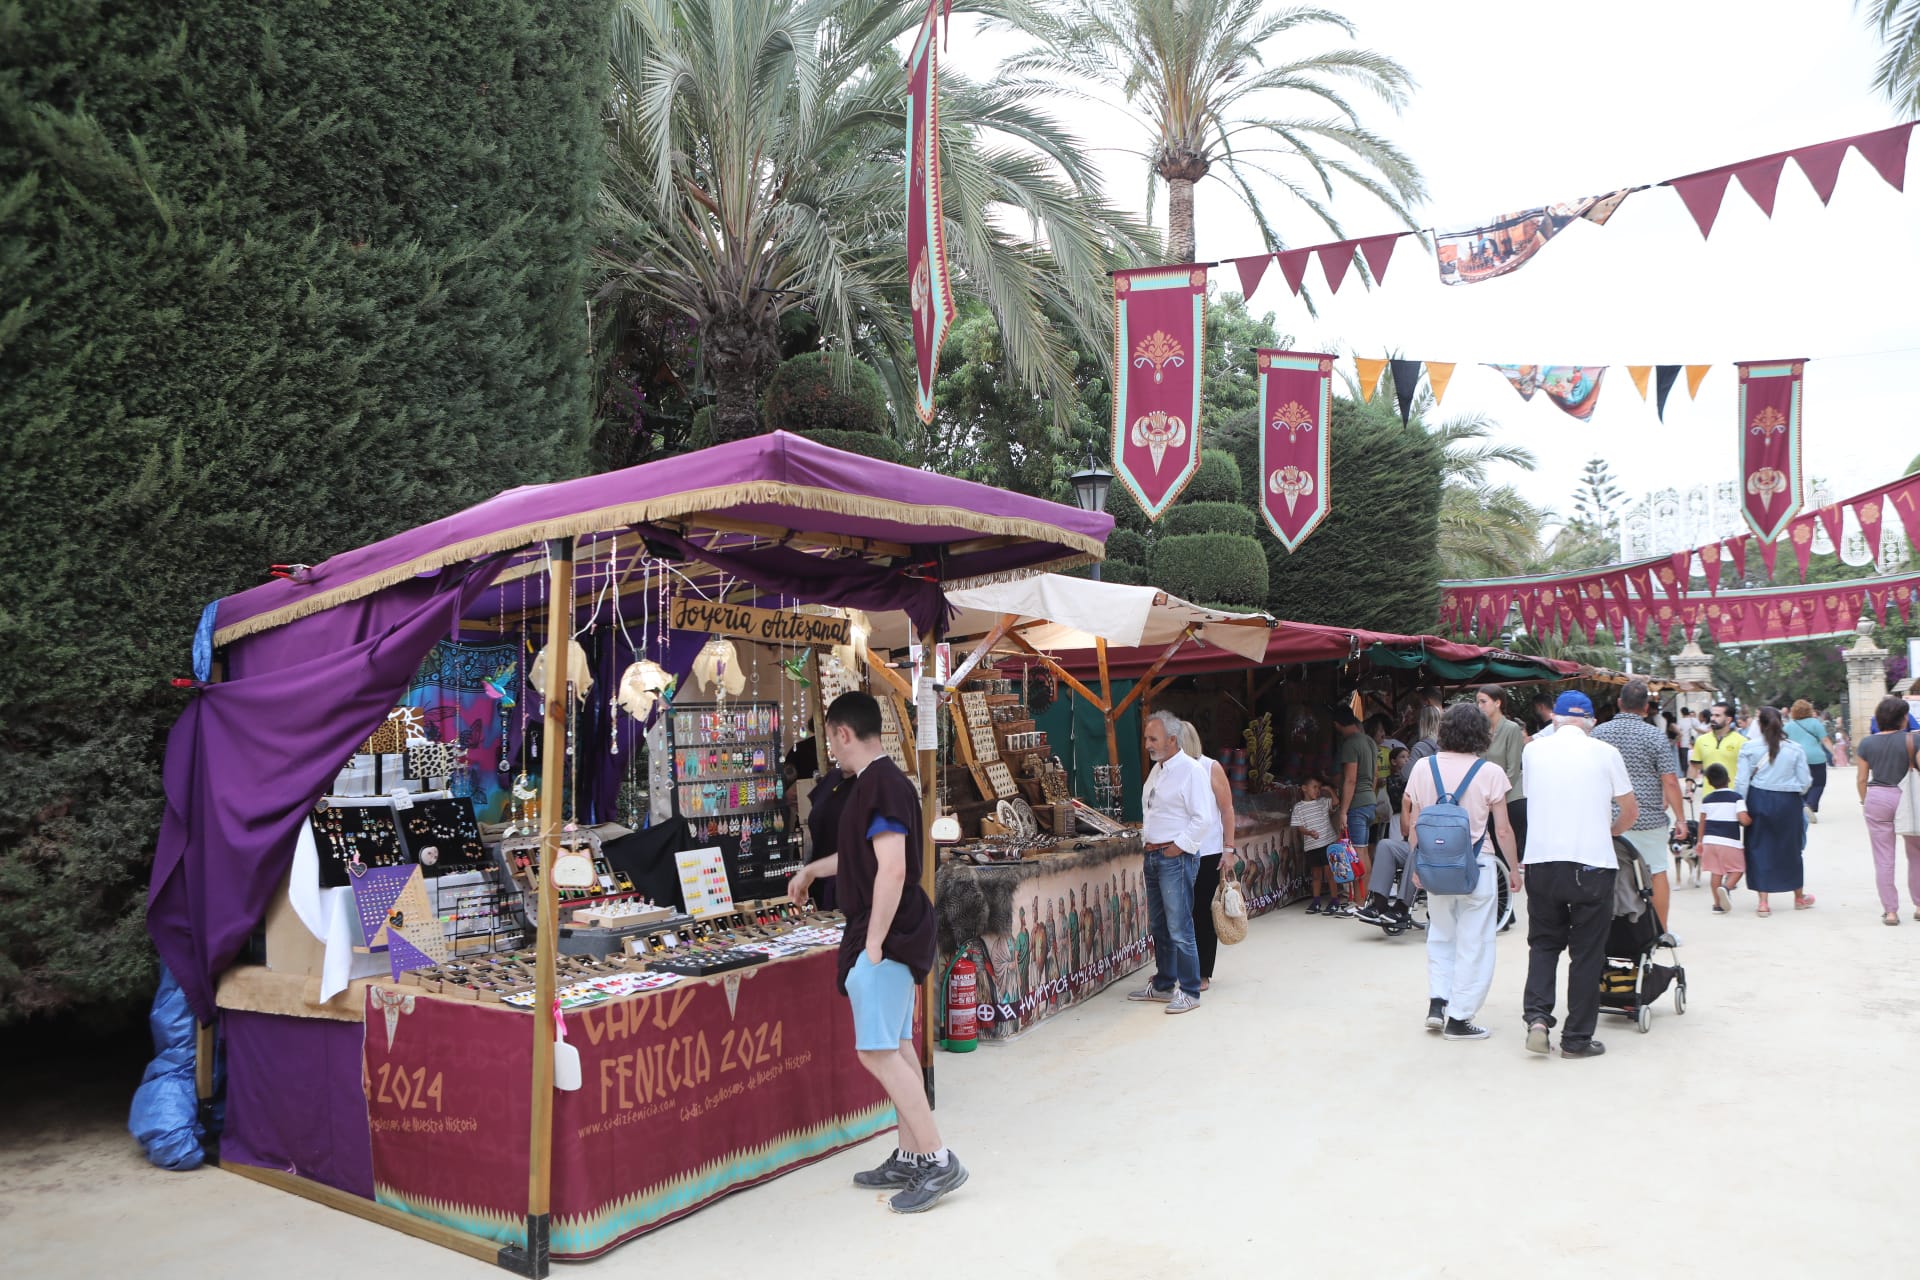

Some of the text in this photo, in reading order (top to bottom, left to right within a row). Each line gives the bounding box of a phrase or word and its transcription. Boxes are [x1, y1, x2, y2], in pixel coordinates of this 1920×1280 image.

[762, 610, 849, 645] Artesanal
[376, 1062, 444, 1113] 2024
[600, 1020, 783, 1115] FENICIA 2024
